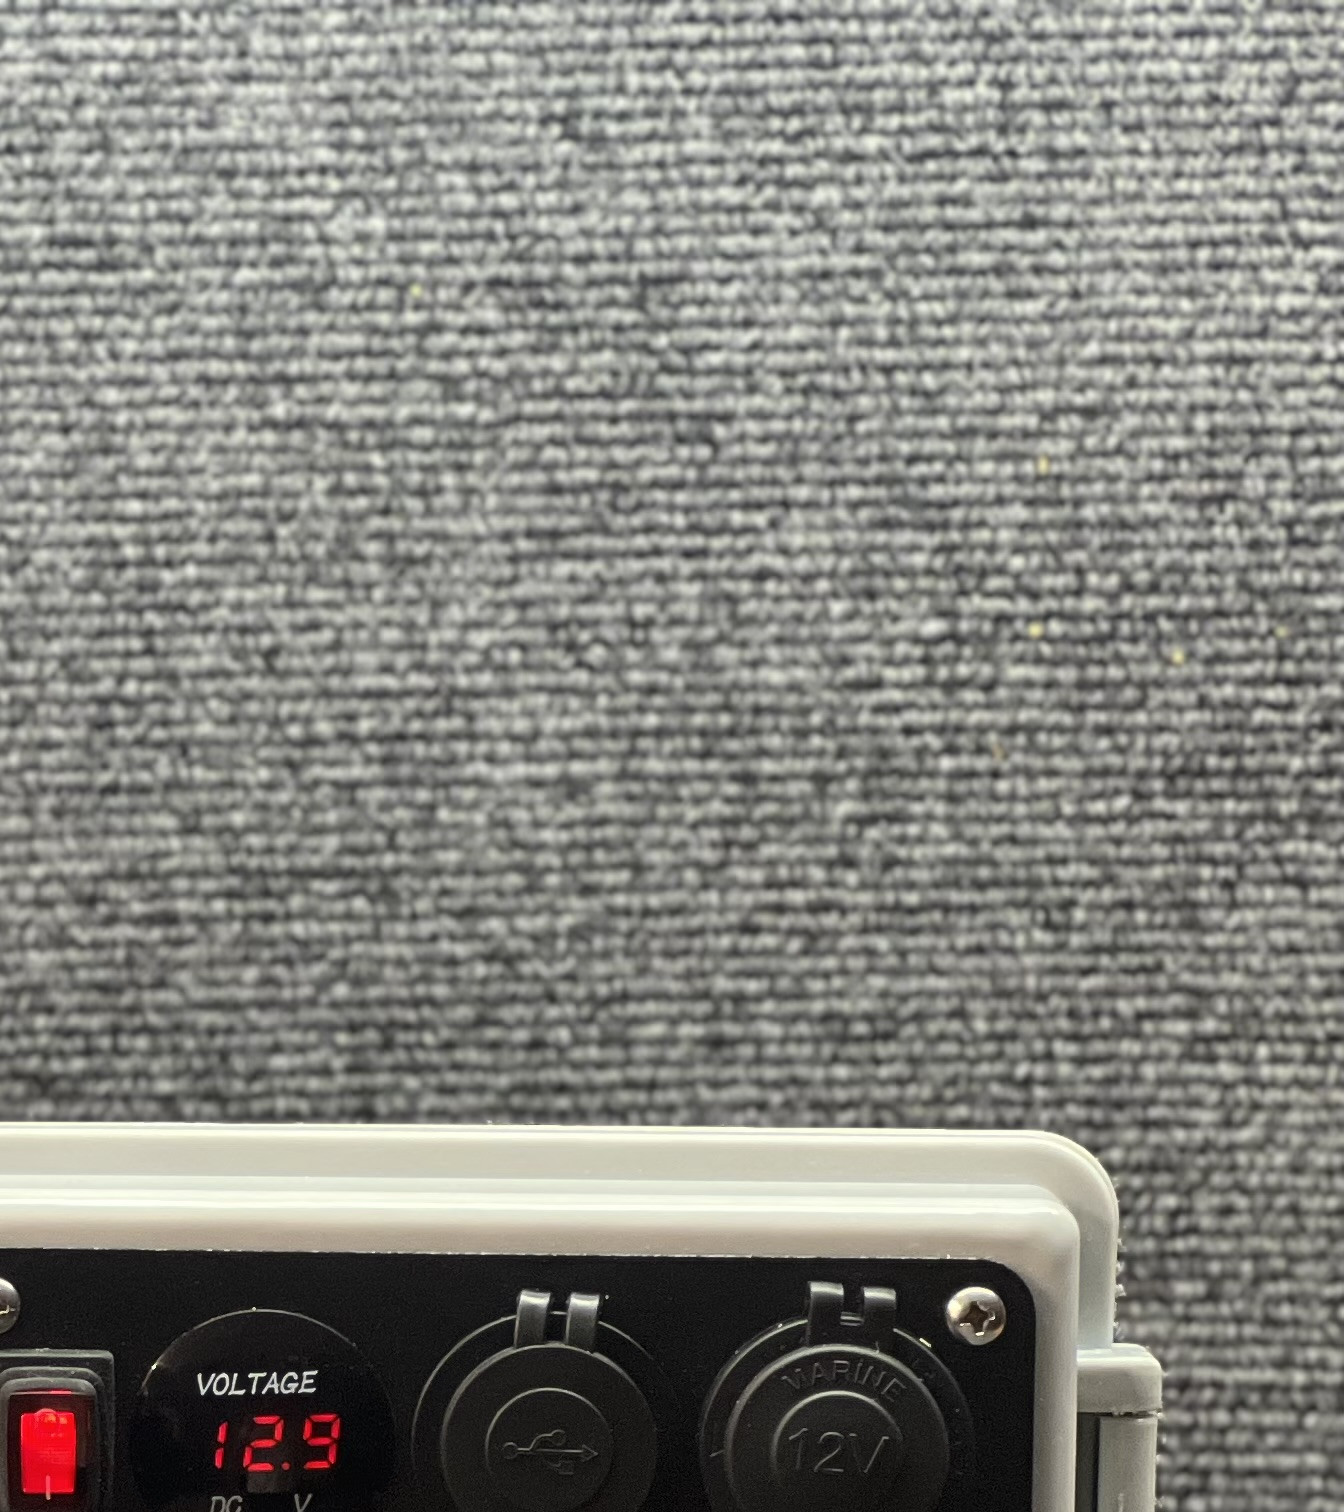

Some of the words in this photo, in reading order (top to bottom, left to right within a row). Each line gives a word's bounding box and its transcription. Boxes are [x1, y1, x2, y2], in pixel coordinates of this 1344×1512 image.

[196, 1369, 318, 1396] VOLTAGE
[780, 1358, 908, 1403] MARINE
[215, 1413, 340, 1472] 12.9
[788, 1427, 890, 1474] 12V
